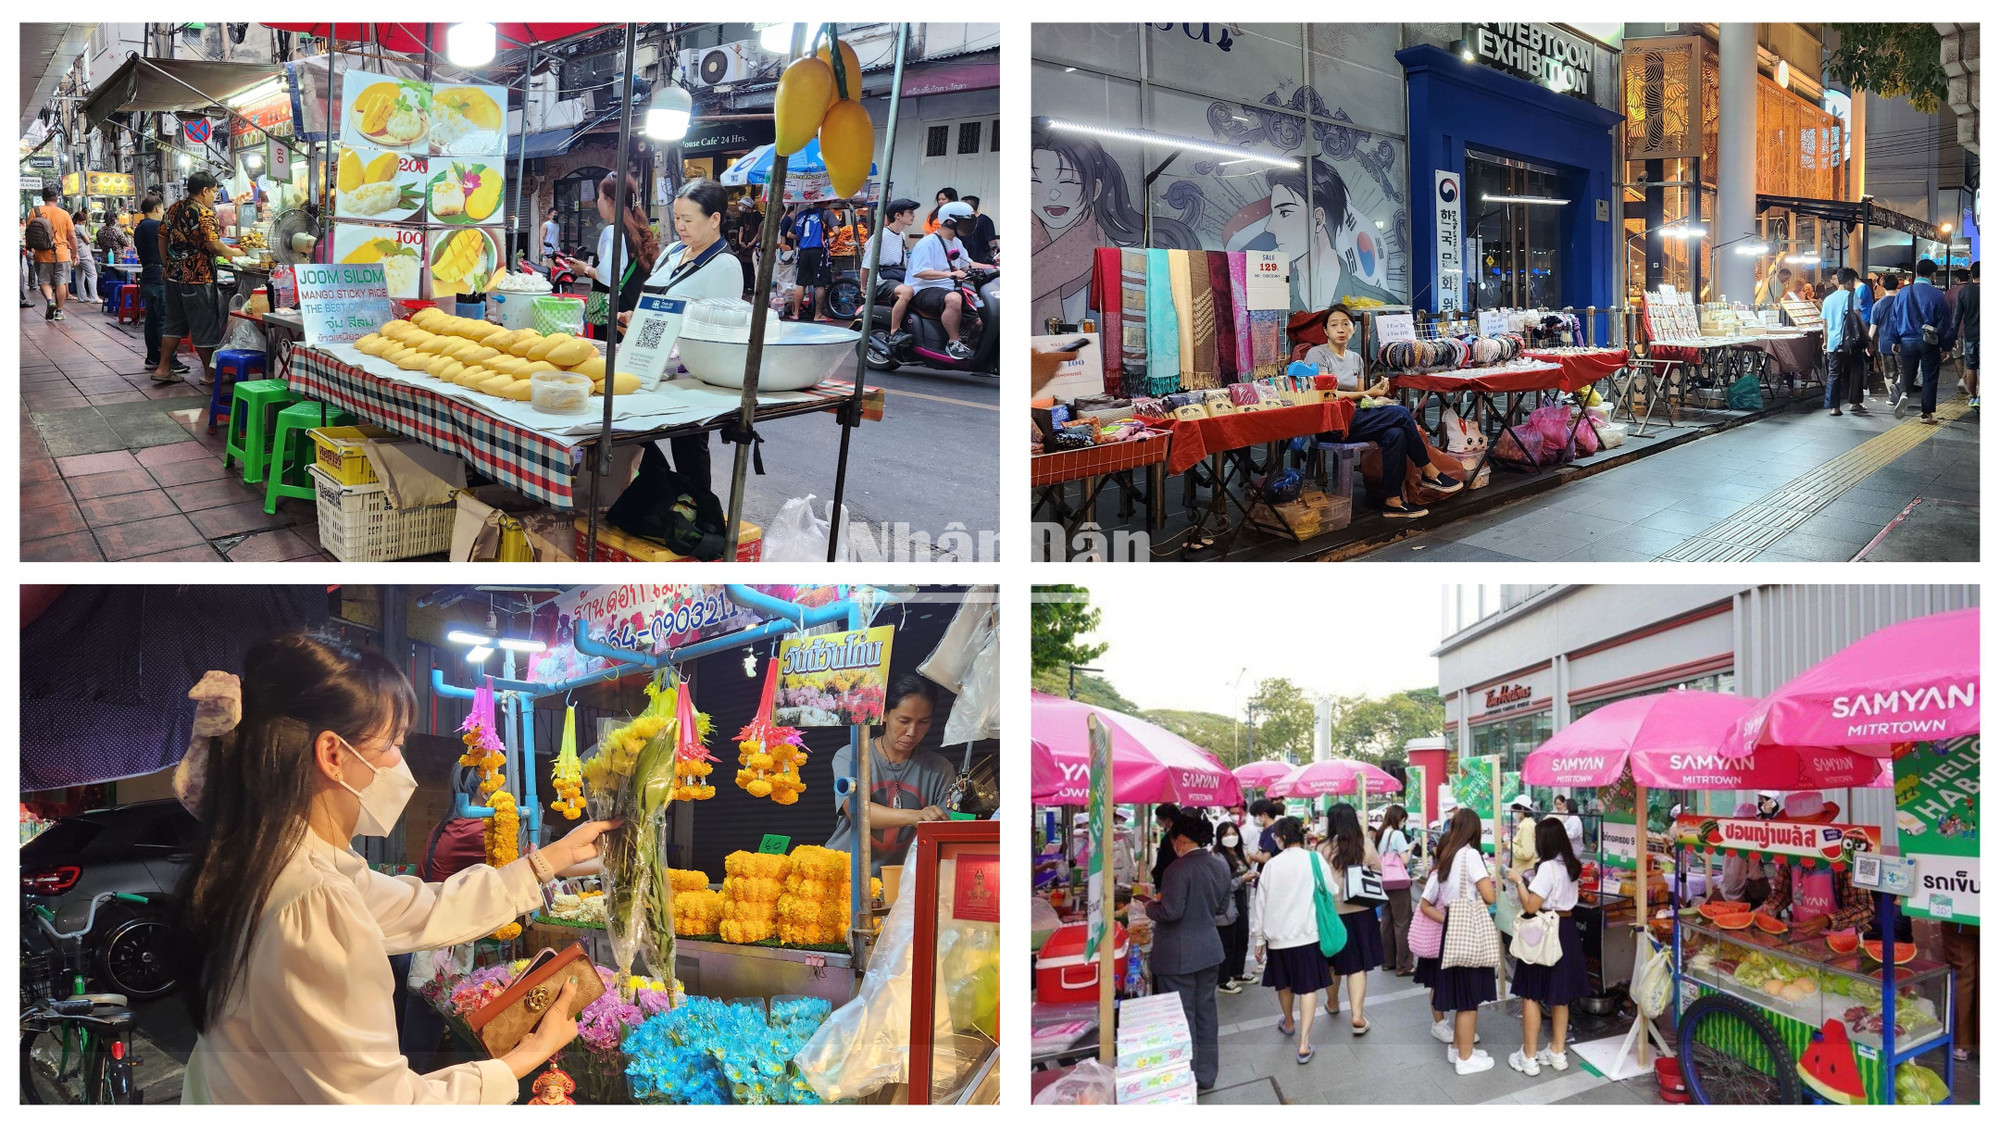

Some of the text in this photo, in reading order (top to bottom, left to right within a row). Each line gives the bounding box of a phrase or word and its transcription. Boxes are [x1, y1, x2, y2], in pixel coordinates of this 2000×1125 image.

[1498, 22, 1592, 72] WEBTOON
[1479, 27, 1588, 95] EXHIBITION
[682, 140, 700, 148] ouse
[720, 136, 731, 144] 24
[731, 134, 747, 143] Hrs.
[399, 157, 429, 174] 200
[395, 230, 424, 245] 100
[300, 268, 385, 285] JOOM SILOM
[301, 288, 388, 300] MANGO STICKY RICE
[305, 304, 323, 314] THE
[325, 303, 346, 313] BEST
[348, 315, 374, 328] สีลม
[598, 592, 738, 650] 64-0903211
[1832, 682, 1975, 719] SAMYAN
[1847, 719, 1947, 737] MITRTOWN
[1552, 756, 1604, 771] SAMYAN
[1670, 754, 1755, 770] SAMYAN
[1813, 756, 1854, 772] SAMYAN
[1182, 772, 1220, 789] SAMYAN
[1365, 778, 1386, 786] AMYAN
[1556, 774, 1594, 783] MITRTOWN
[1682, 775, 1742, 784] MITRTOWN
[1914, 775, 1980, 820] HAB
[765, 838, 782, 851] 60
[1631, 836, 1636, 846] 9
[1804, 896, 1829, 907] YAN
